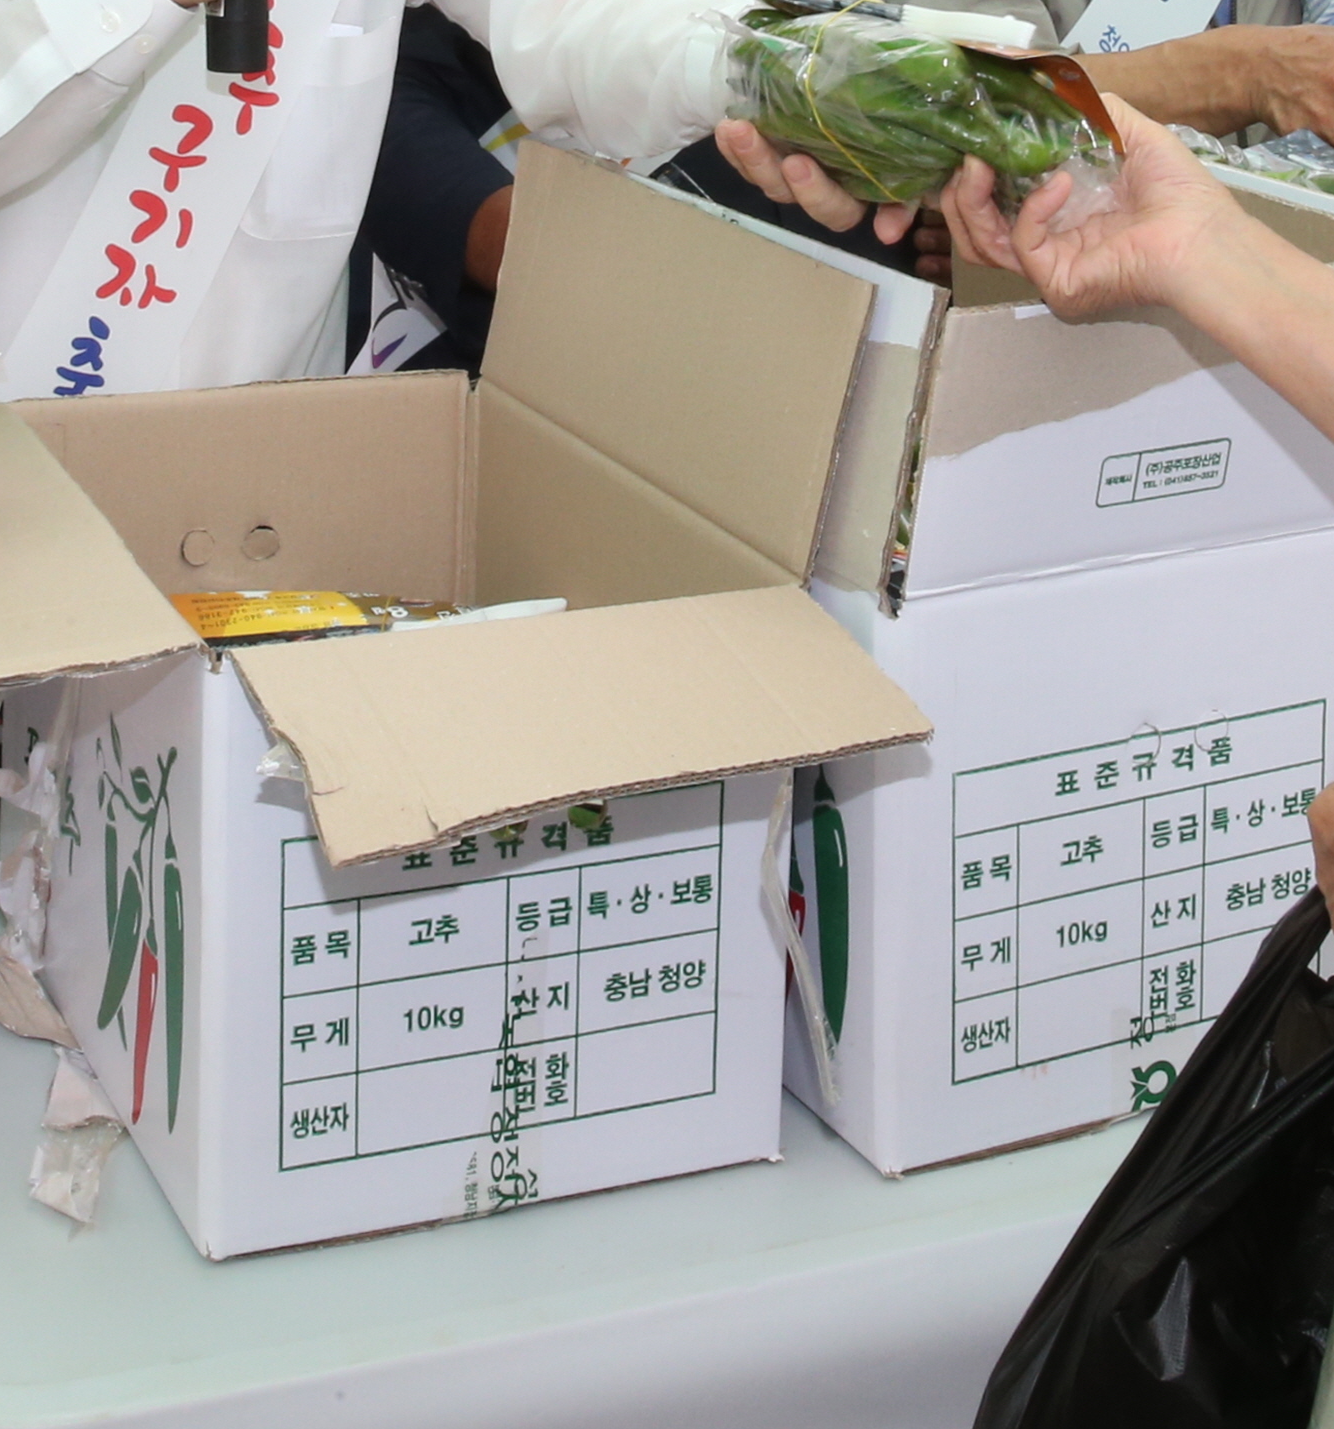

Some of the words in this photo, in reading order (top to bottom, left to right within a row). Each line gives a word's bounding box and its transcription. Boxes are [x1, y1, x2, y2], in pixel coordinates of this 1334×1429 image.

[1150, 814, 1199, 851] 등급
[1060, 834, 1104, 869] 고추
[961, 851, 1013, 891] 품목
[1225, 877, 1266, 911] 충남
[1271, 867, 1312, 901] 청양
[515, 896, 573, 931] 등급
[1150, 894, 1198, 930] 산지
[290, 929, 352, 966] 품목
[408, 914, 460, 947] 고추
[1055, 918, 1108, 949] 10kg
[961, 936, 1013, 973] 무게
[514, 980, 571, 1019] 산지
[603, 972, 653, 1004] 충남
[657, 960, 708, 996] 청양
[290, 1016, 351, 1052] 무게
[402, 1003, 466, 1034] 10kg
[960, 1017, 1012, 1054] 생산자
[290, 1103, 350, 1139] 생산자
